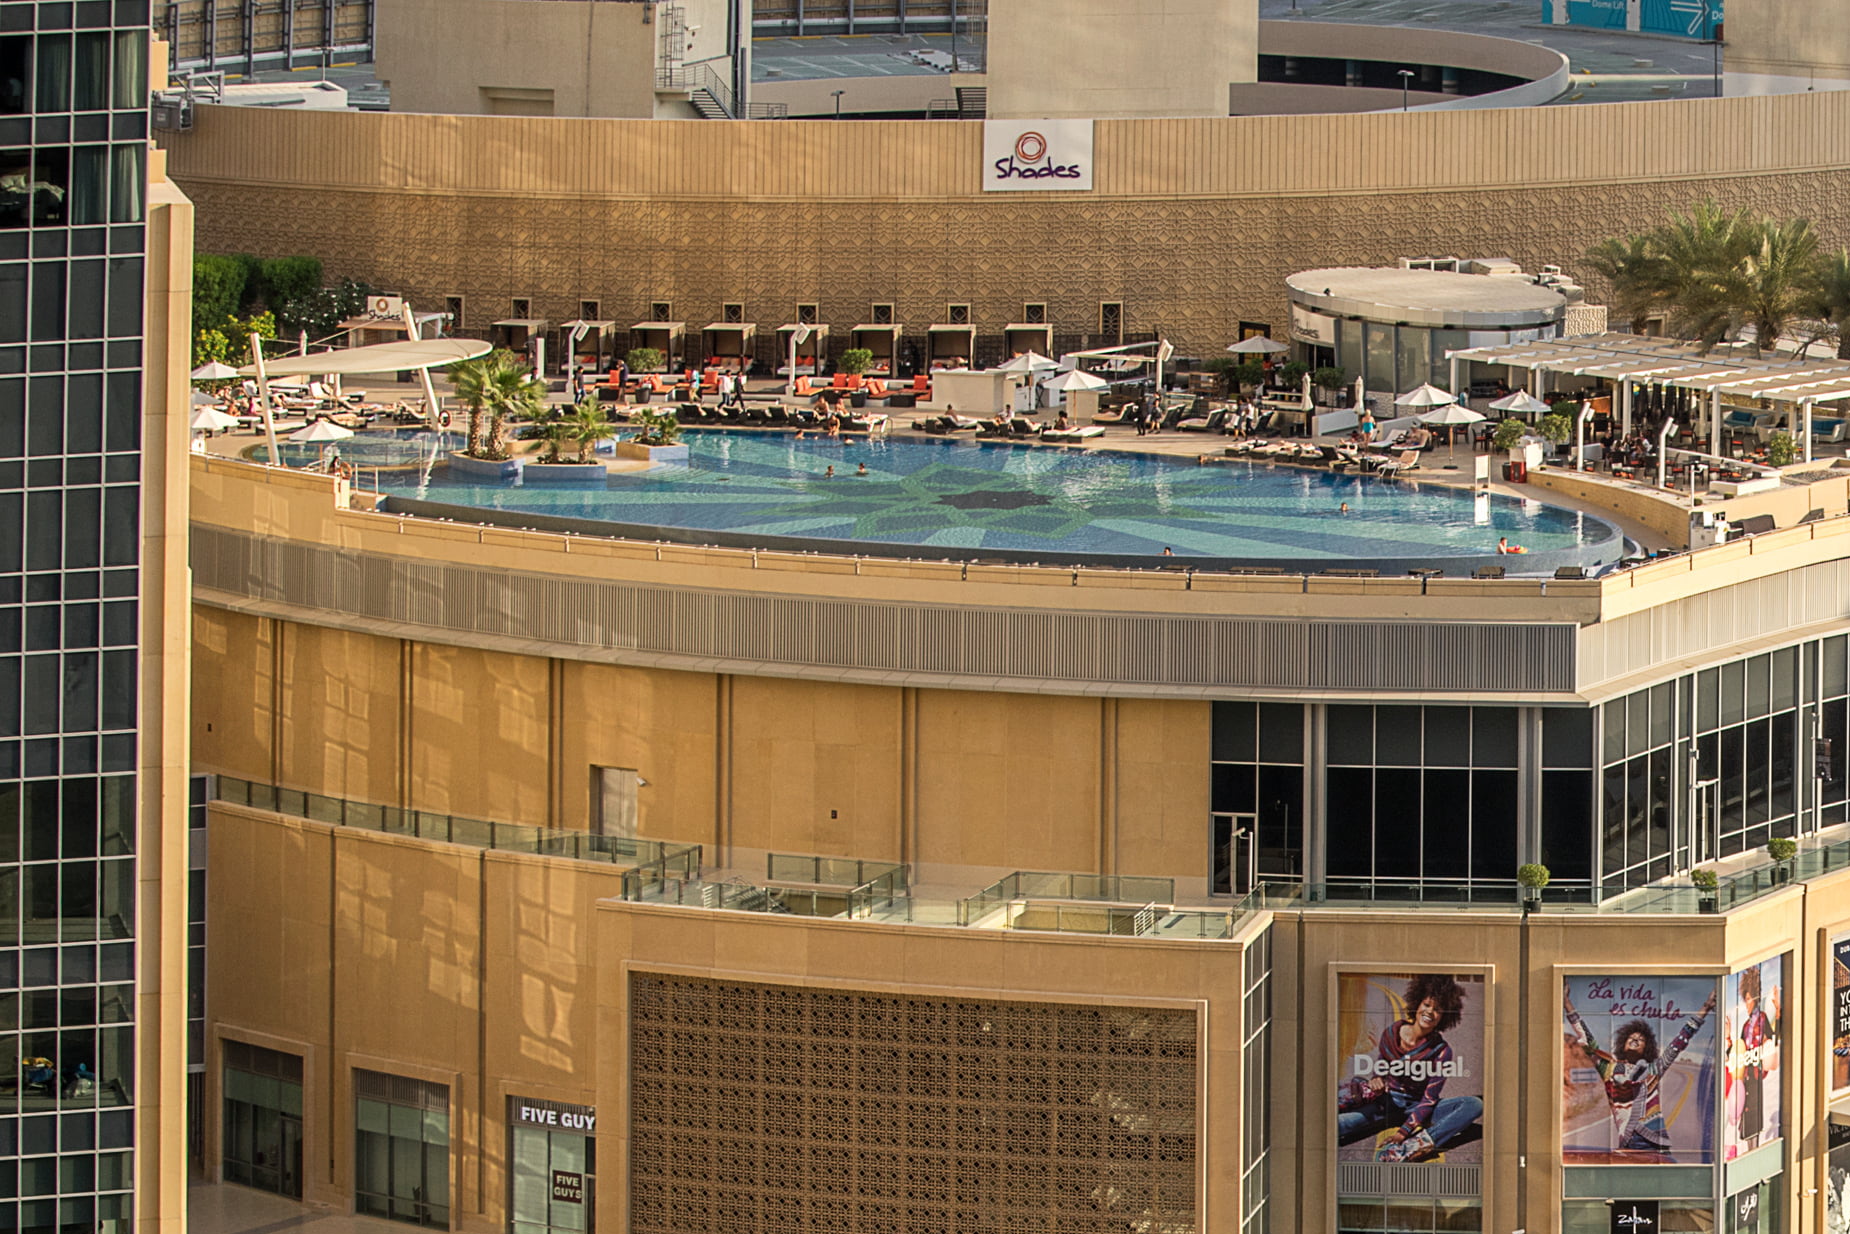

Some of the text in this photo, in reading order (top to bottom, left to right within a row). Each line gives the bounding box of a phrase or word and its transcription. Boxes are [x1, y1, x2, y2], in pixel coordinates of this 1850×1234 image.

[995, 156, 1080, 179] Shades
[1588, 978, 1656, 1000] La vida
[1610, 1000, 1686, 1020] es chula
[1840, 1006, 1848, 1017] IN
[1354, 1054, 1464, 1082] Desigual
[522, 1106, 557, 1125] FIVE
[557, 1175, 579, 1186] FIVE
[554, 1187, 582, 1199] GUYS
